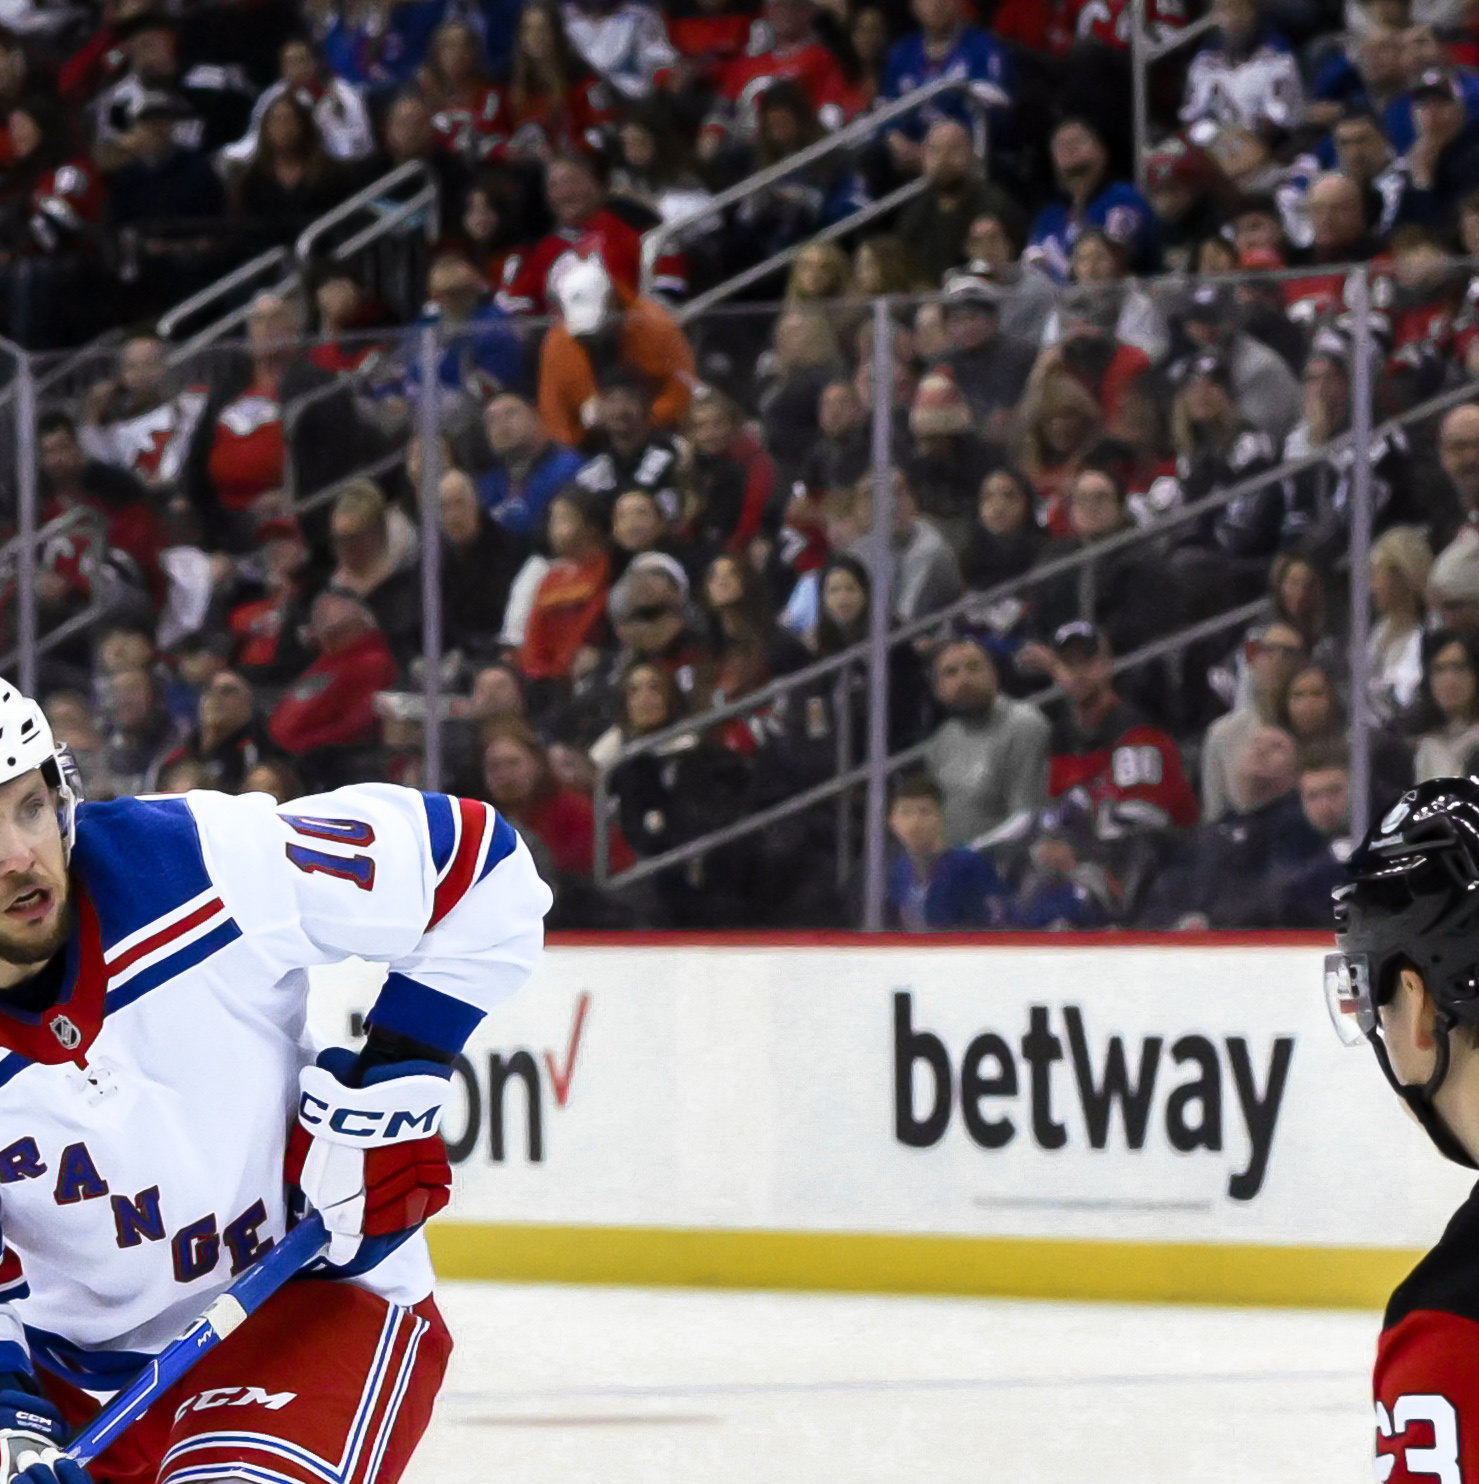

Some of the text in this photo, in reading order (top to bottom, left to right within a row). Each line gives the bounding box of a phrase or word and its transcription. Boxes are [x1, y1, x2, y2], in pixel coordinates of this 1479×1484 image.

[275, 813, 376, 892] 10
[299, 1089, 441, 1138] CCM
[891, 991, 1296, 1201] betway
